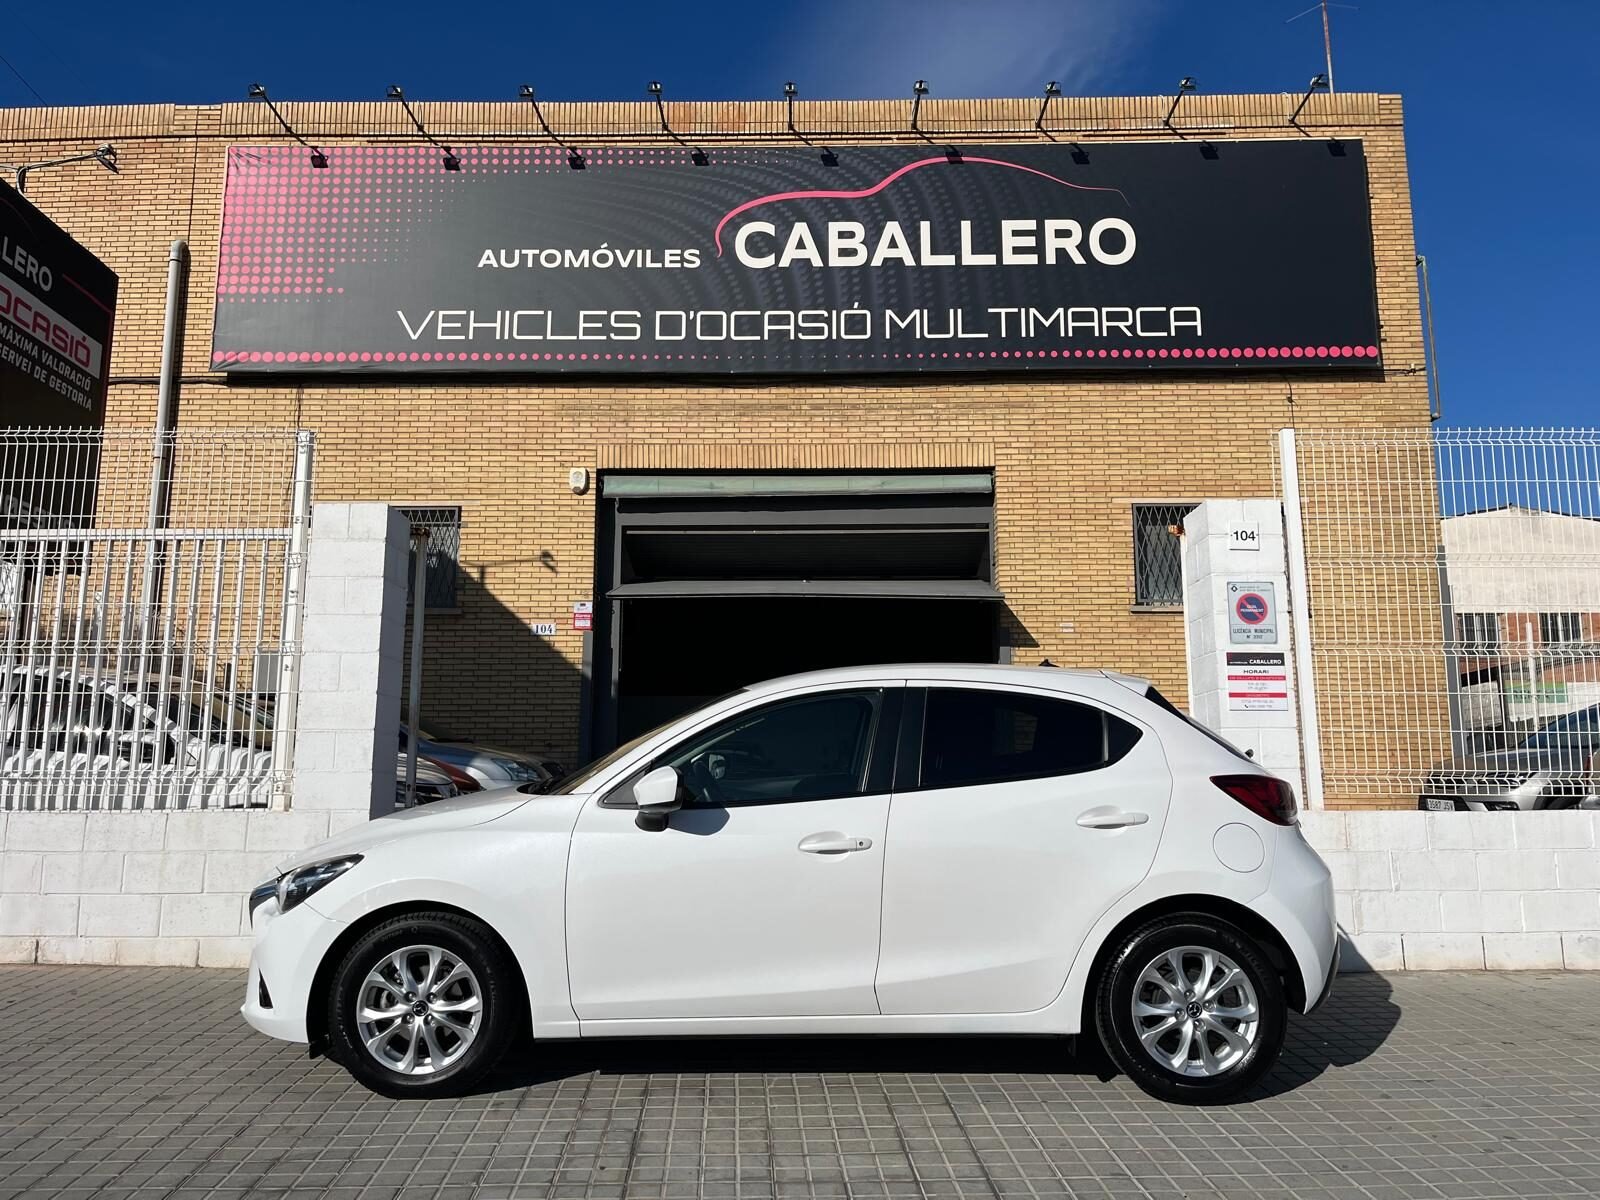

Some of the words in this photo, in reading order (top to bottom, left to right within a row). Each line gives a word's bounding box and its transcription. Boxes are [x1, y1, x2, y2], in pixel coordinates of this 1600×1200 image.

[0, 236, 53, 292] LERO
[478, 243, 700, 269] AUTOMÓVILES
[734, 217, 1137, 269] CABALLERO
[397, 310, 641, 341] VEHICLES
[885, 306, 1203, 340] MULTIMARCA
[33, 365, 48, 384] DE
[49, 374, 92, 412] GESTORIA
[41, 349, 92, 392] VALORACIÓ
[1233, 530, 1256, 541] 104
[535, 624, 553, 634] 104
